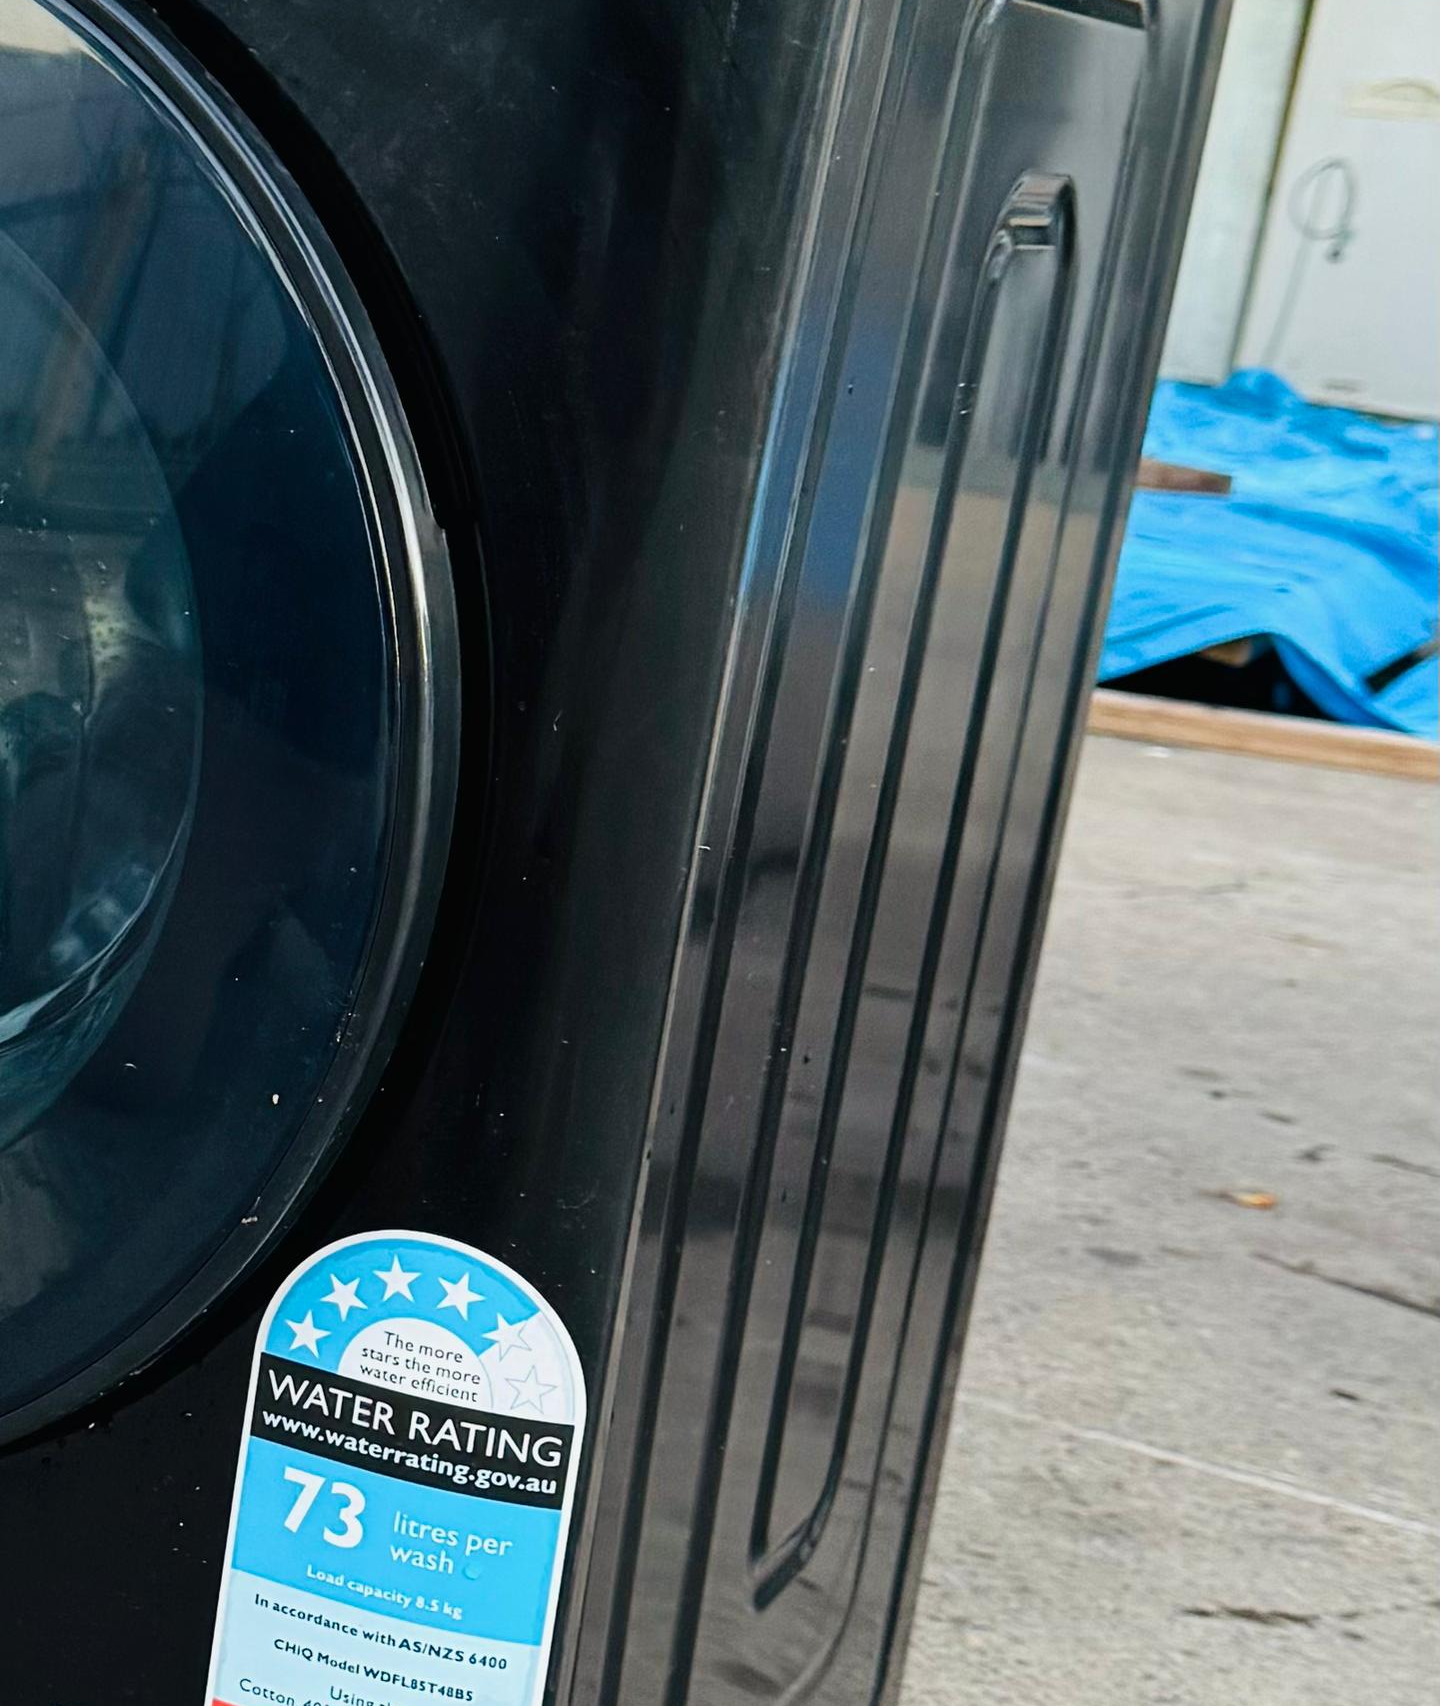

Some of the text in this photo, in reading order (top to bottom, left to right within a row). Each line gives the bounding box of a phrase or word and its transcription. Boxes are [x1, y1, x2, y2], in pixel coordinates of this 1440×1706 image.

[361, 1347, 481, 1386] stars the more
[384, 1330, 463, 1364] The more
[360, 1365, 479, 1404] water efficient
[267, 1369, 563, 1468] WATER RATING
[262, 1409, 557, 1495] www.waterrating.gov.au
[281, 1466, 366, 1549] 73
[392, 1511, 513, 1557] litres per
[389, 1545, 455, 1575] wash
[306, 1564, 463, 1621] Load capacity 8.5 kg
[255, 1594, 508, 1670] In accordance with AS/NZS 6400
[316, 1651, 360, 1675] Model
[363, 1666, 474, 1702] WDFL85T48B5
